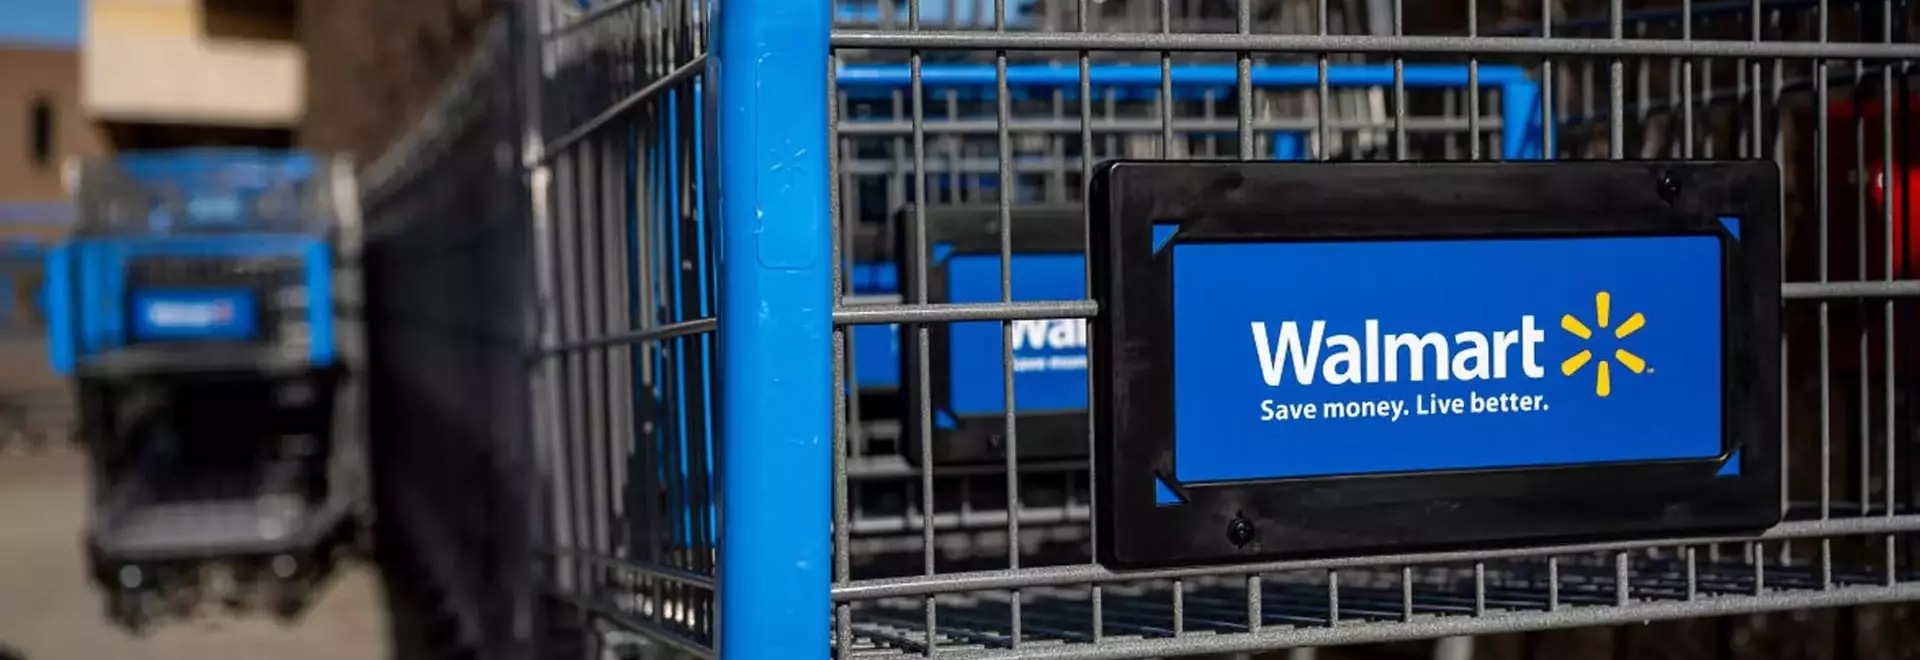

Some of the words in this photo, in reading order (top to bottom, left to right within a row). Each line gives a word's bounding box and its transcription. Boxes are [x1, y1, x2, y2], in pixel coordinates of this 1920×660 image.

[1251, 315, 1544, 386] Walmart
[1261, 399, 1317, 421] Save
[1323, 400, 1409, 422] money.
[1417, 393, 1465, 415] Live
[1469, 391, 1549, 413] better.
